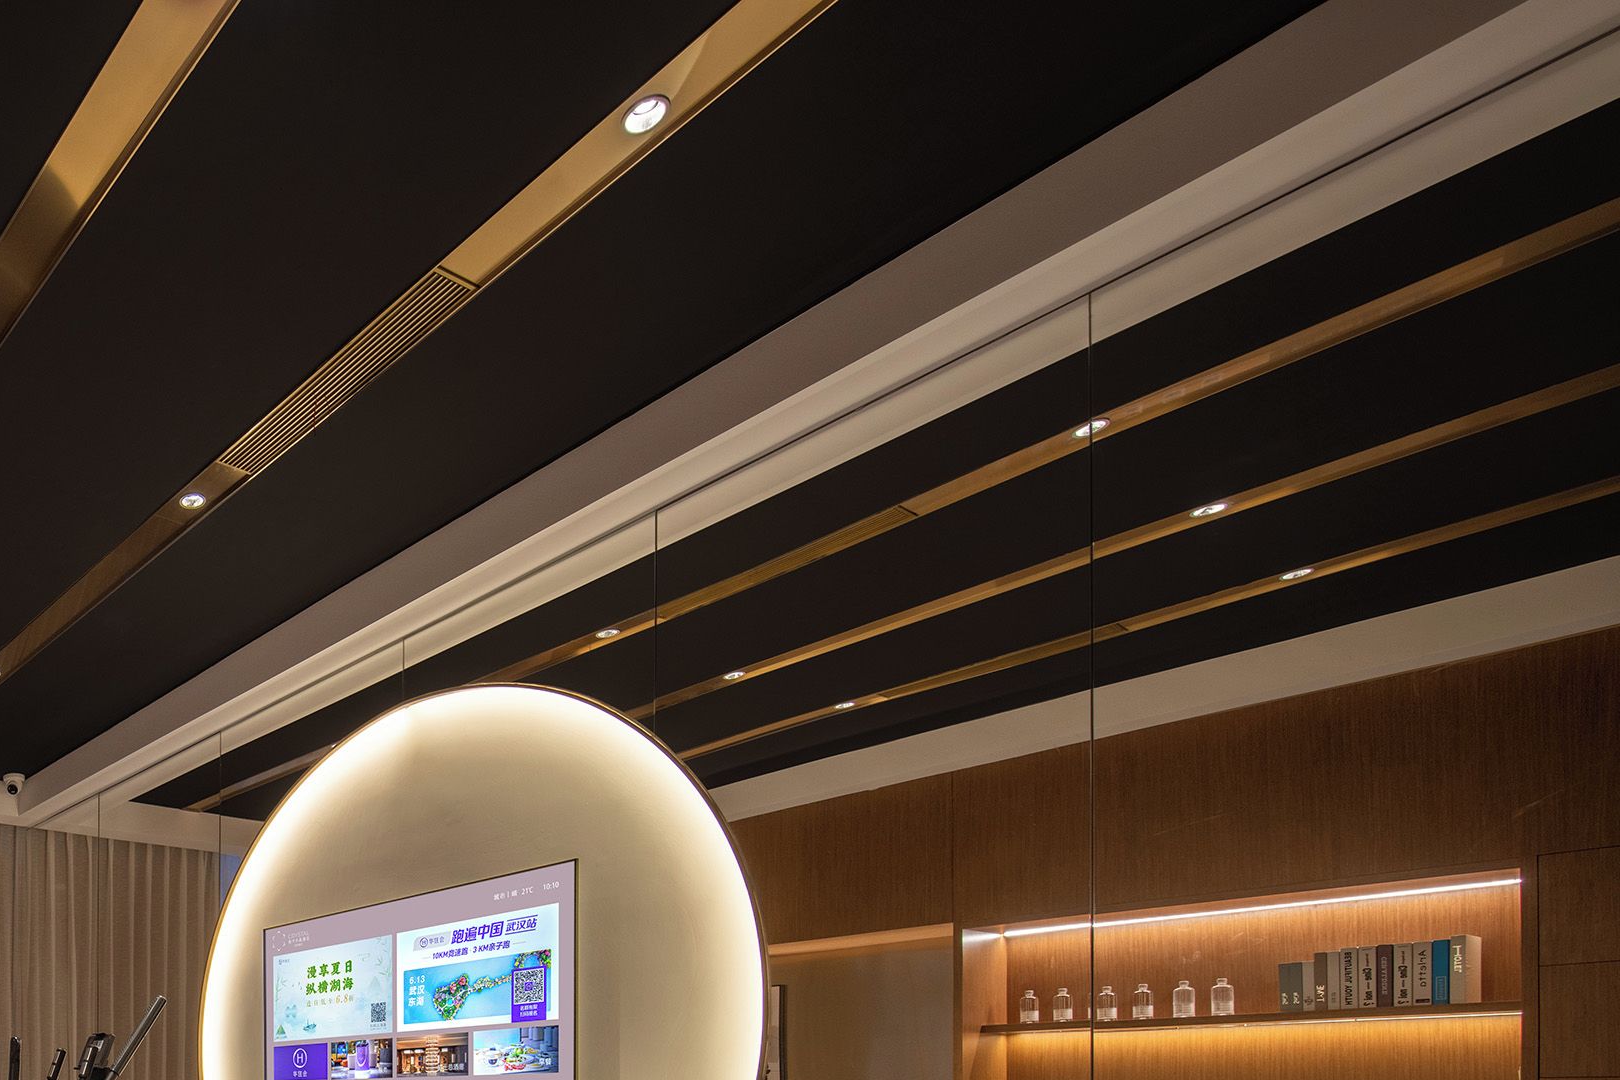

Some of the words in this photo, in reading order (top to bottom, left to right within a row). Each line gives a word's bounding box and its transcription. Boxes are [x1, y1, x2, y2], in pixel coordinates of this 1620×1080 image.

[543, 881, 560, 890] 10:10
[451, 921, 505, 945] 跑遍中国
[506, 917, 538, 932] 武汉站
[306, 960, 353, 979] 漫享夏日
[305, 977, 354, 996] 纵横湖海
[409, 974, 426, 985] 6.13
[408, 984, 425, 996] 武汉
